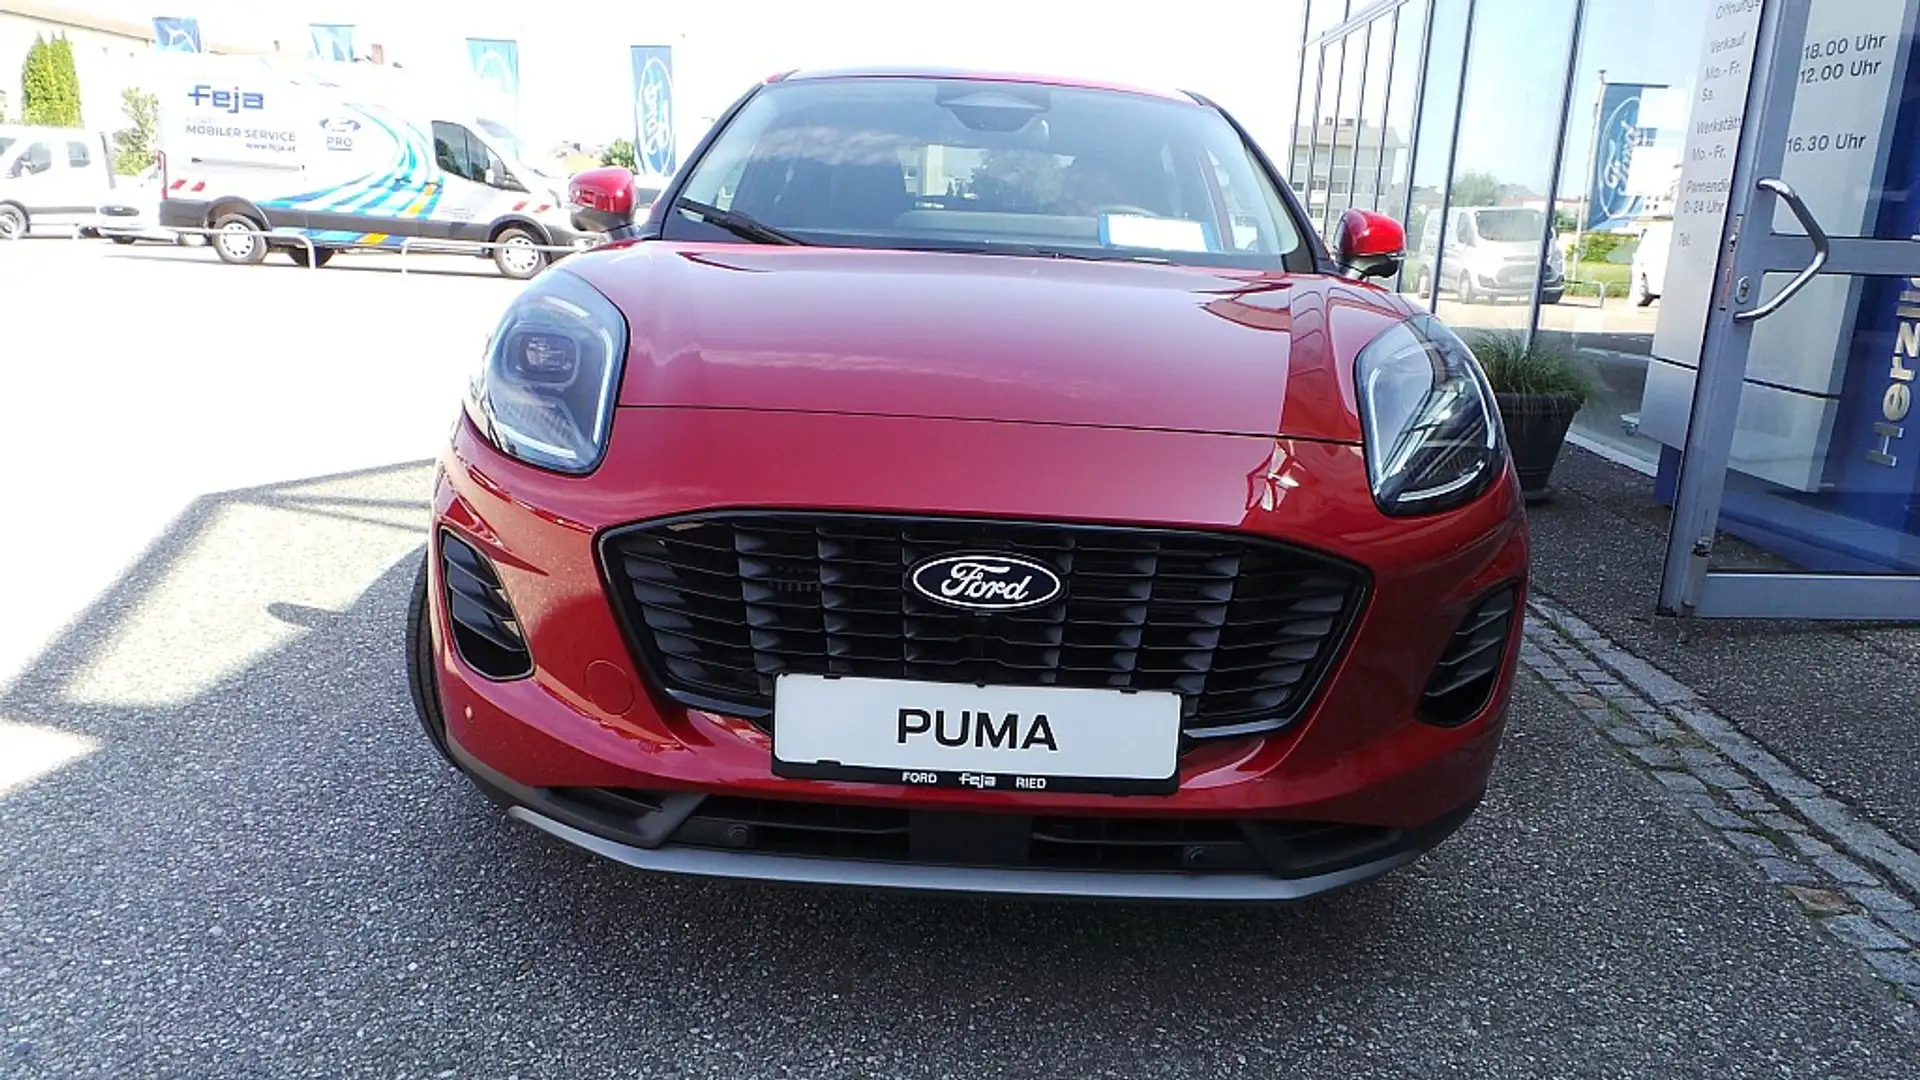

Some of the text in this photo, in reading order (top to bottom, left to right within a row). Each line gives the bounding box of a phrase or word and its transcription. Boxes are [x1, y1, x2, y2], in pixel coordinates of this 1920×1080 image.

[1710, 32, 1747, 54] Verkauf
[1805, 33, 1887, 60] 18.00 Uhr
[1801, 59, 1882, 84] 12.00 Uhr
[187, 84, 264, 114] feja
[186, 125, 297, 142] MOBILER SERVICE
[326, 136, 353, 147] PRO
[1787, 133, 1866, 152] 16.30 Uhr
[1706, 200, 1725, 213] Uhr
[1866, 234, 1920, 467] Herzli
[941, 562, 1033, 600] Ford
[897, 708, 1058, 751] PUMA
[902, 771, 938, 784] FORD
[1015, 776, 1048, 789] RIED
